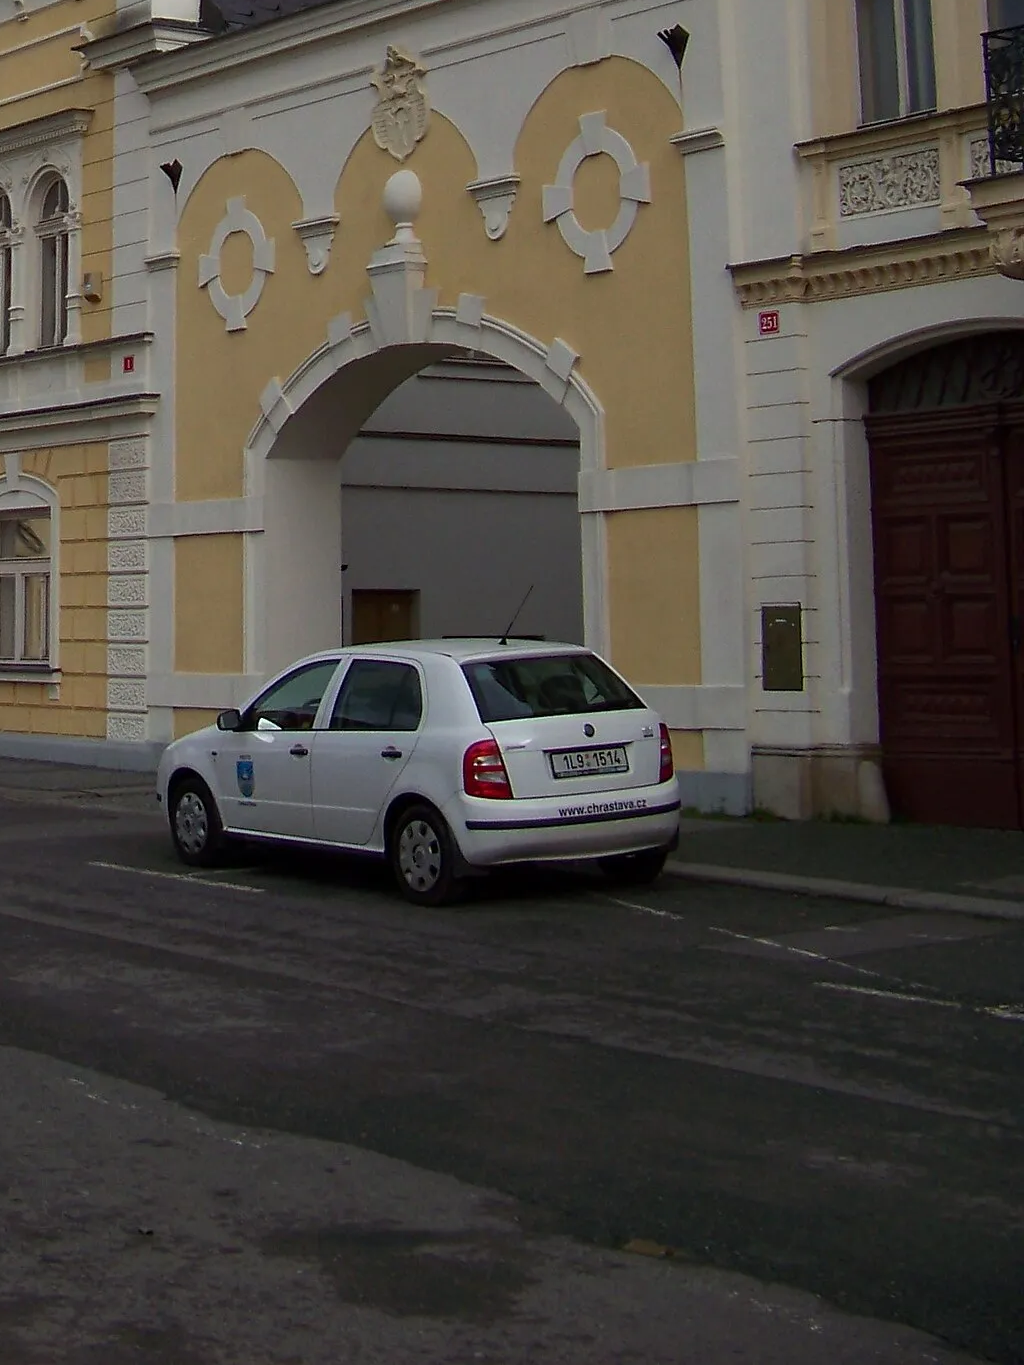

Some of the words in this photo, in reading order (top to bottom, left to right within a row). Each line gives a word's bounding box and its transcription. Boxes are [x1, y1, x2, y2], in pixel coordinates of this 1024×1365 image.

[761, 316, 777, 329] 251
[563, 753, 584, 770] 1L9
[592, 750, 621, 767] 1514
[558, 798, 648, 817] www.chrastava.cz
